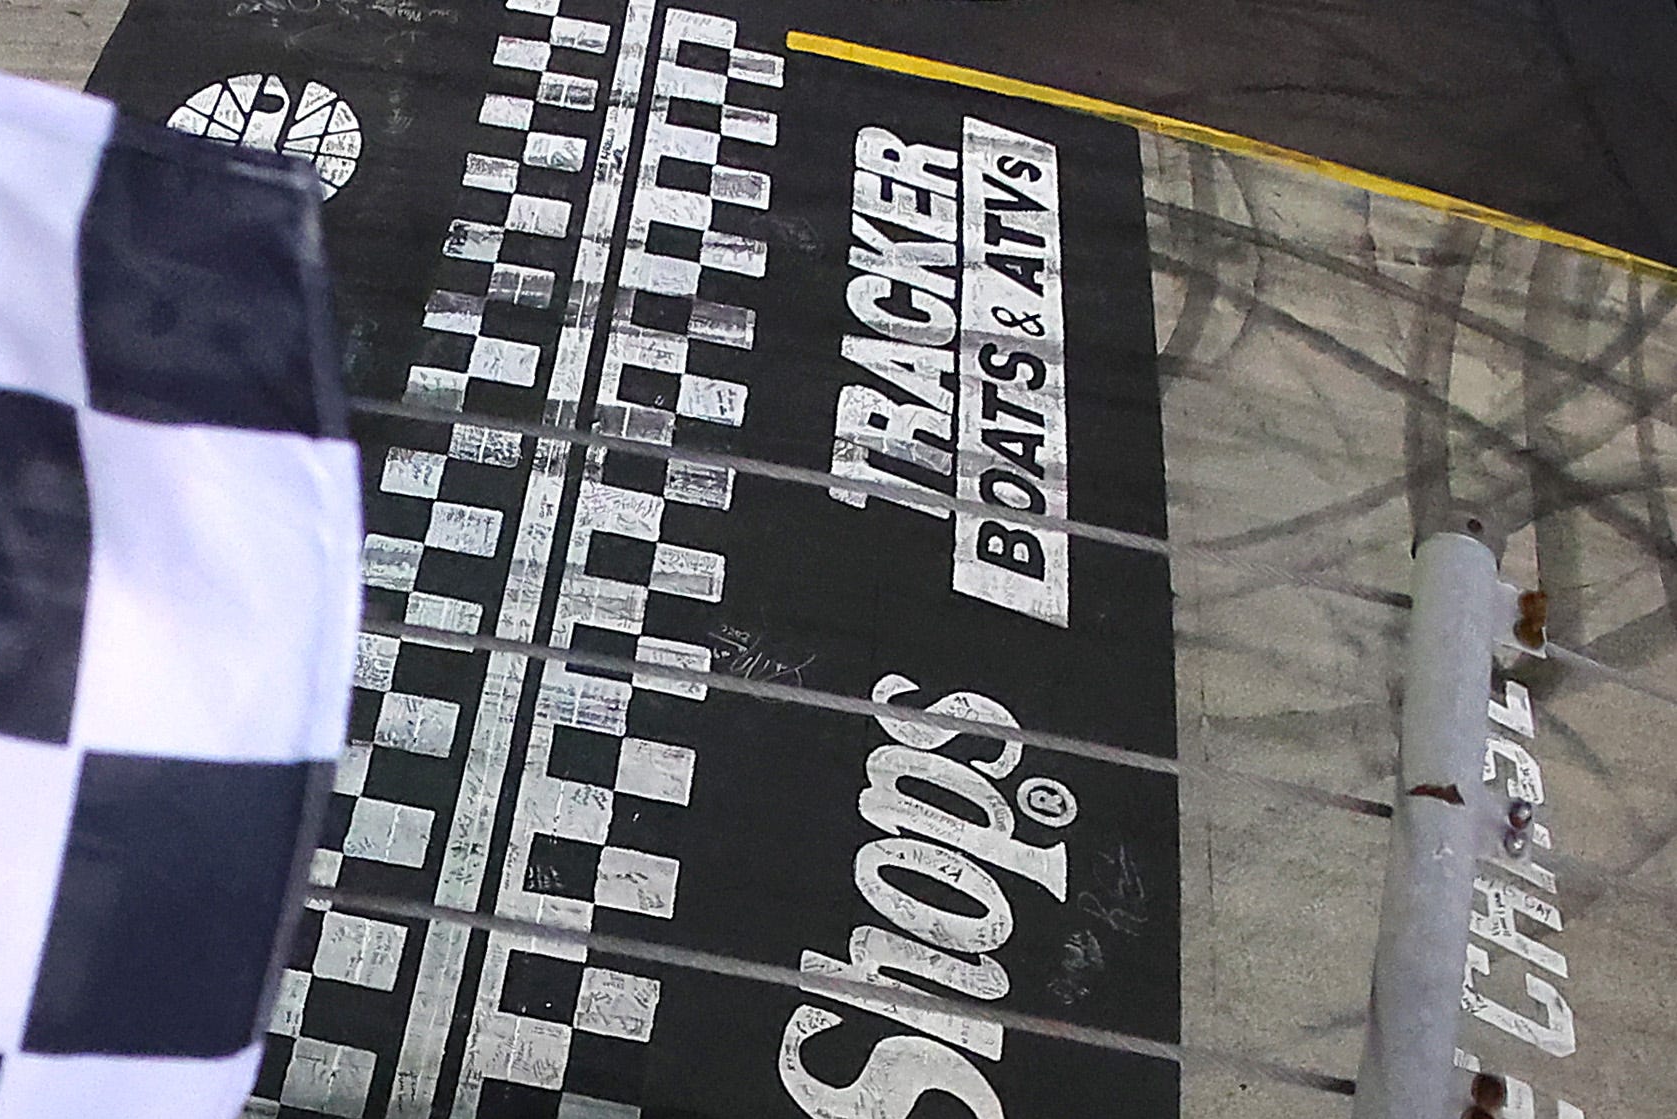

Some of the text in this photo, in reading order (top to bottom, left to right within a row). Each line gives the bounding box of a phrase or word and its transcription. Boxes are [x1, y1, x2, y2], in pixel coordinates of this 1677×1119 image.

[828, 126, 959, 520] TRACKER
[977, 154, 1051, 582] BOATS & ATVs
